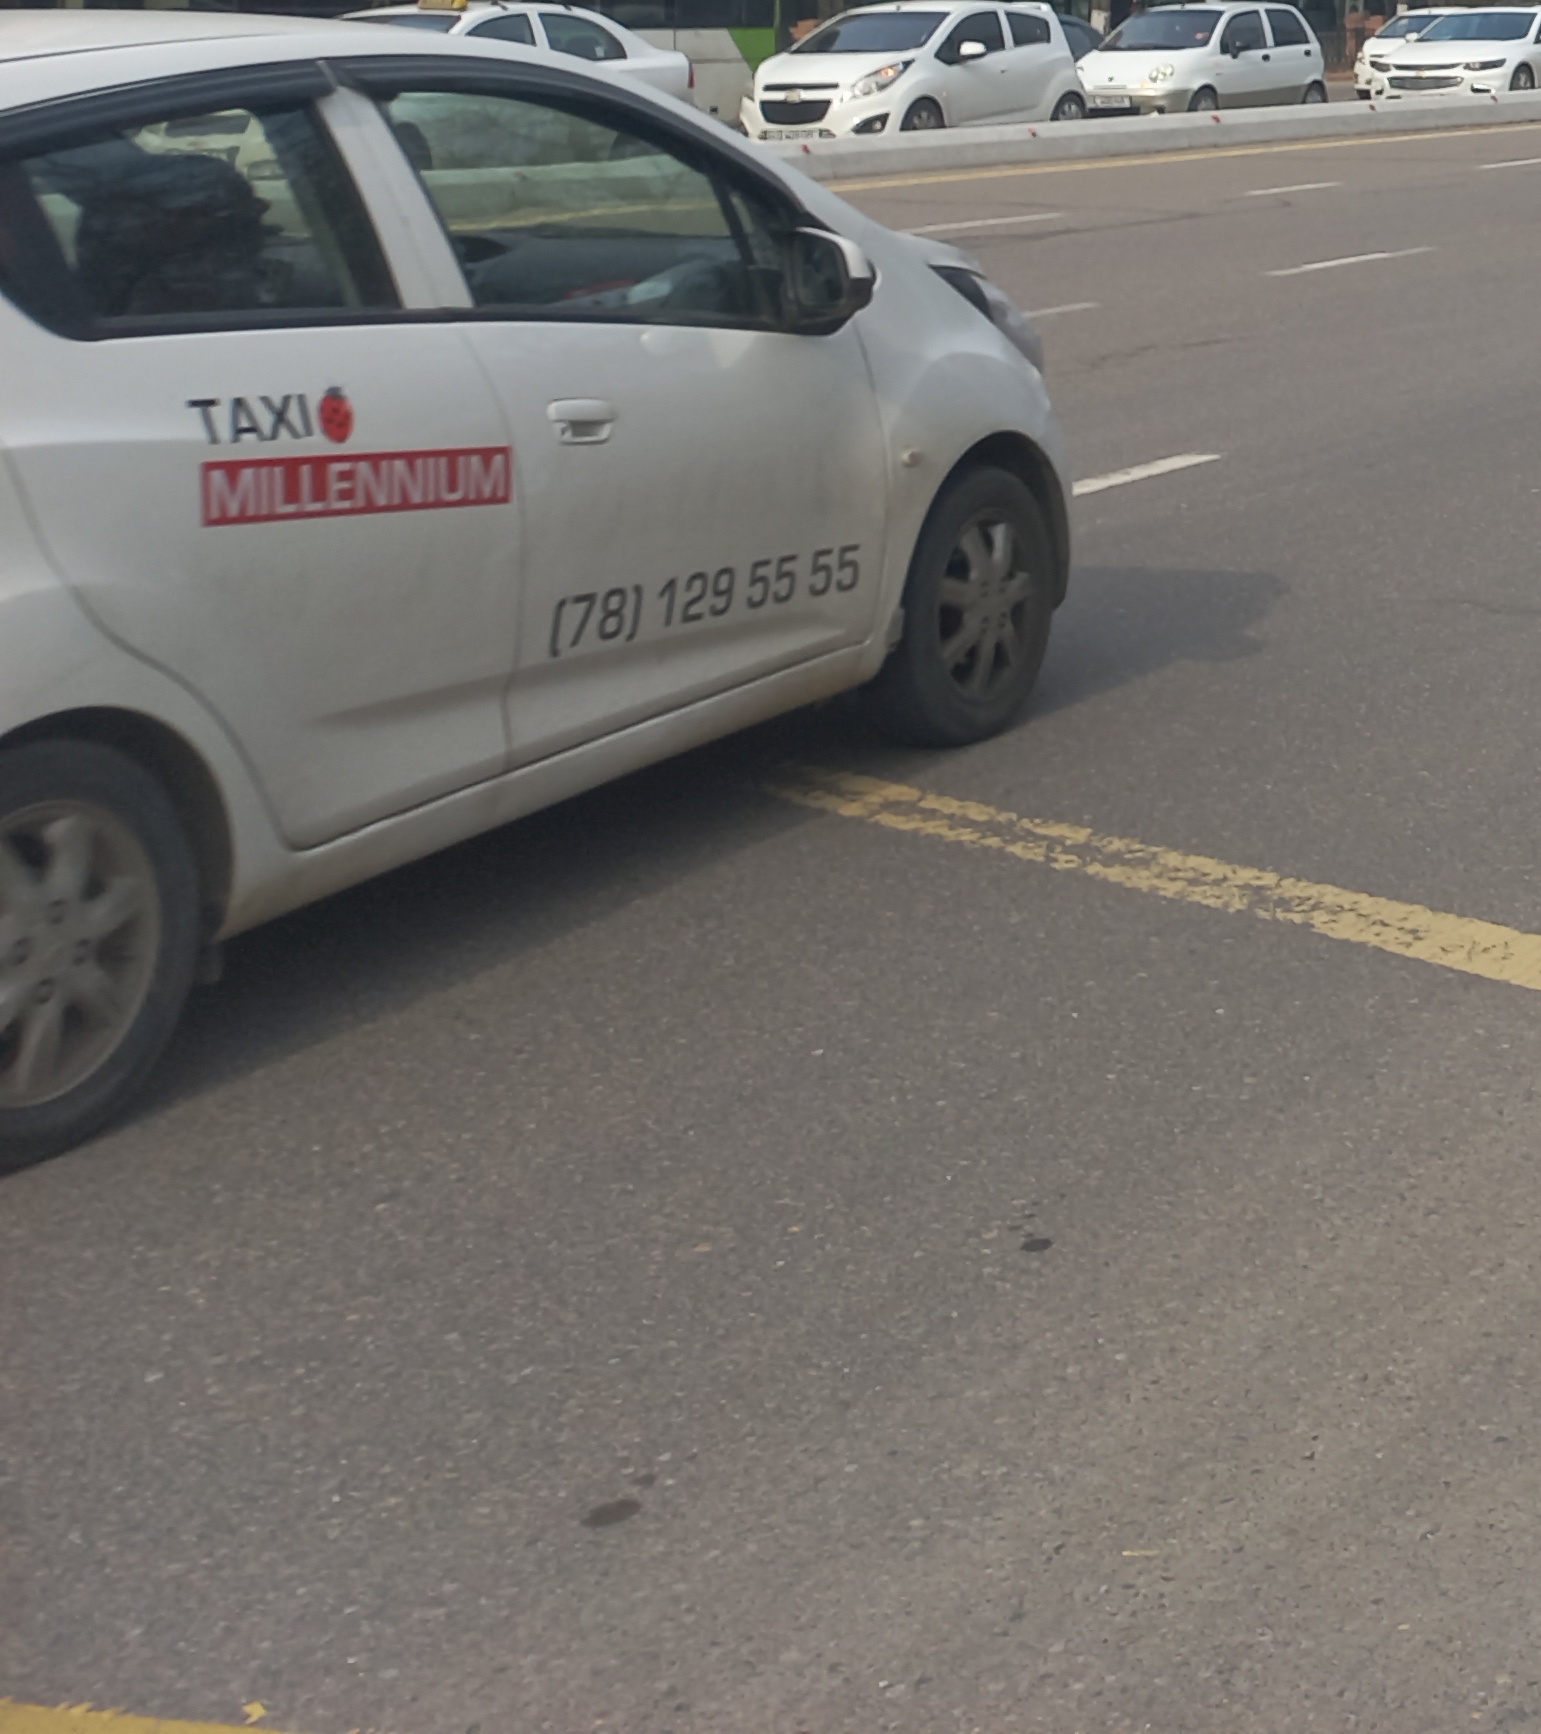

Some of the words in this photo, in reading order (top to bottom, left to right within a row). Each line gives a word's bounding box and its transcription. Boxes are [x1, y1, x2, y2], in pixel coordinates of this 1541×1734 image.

[186, 393, 314, 445] TAXI
[206, 453, 507, 520] MILLENNIUM
[549, 583, 643, 658] (78)
[657, 566, 736, 627] 129
[746, 553, 799, 610] 55
[808, 543, 861, 597] 55
